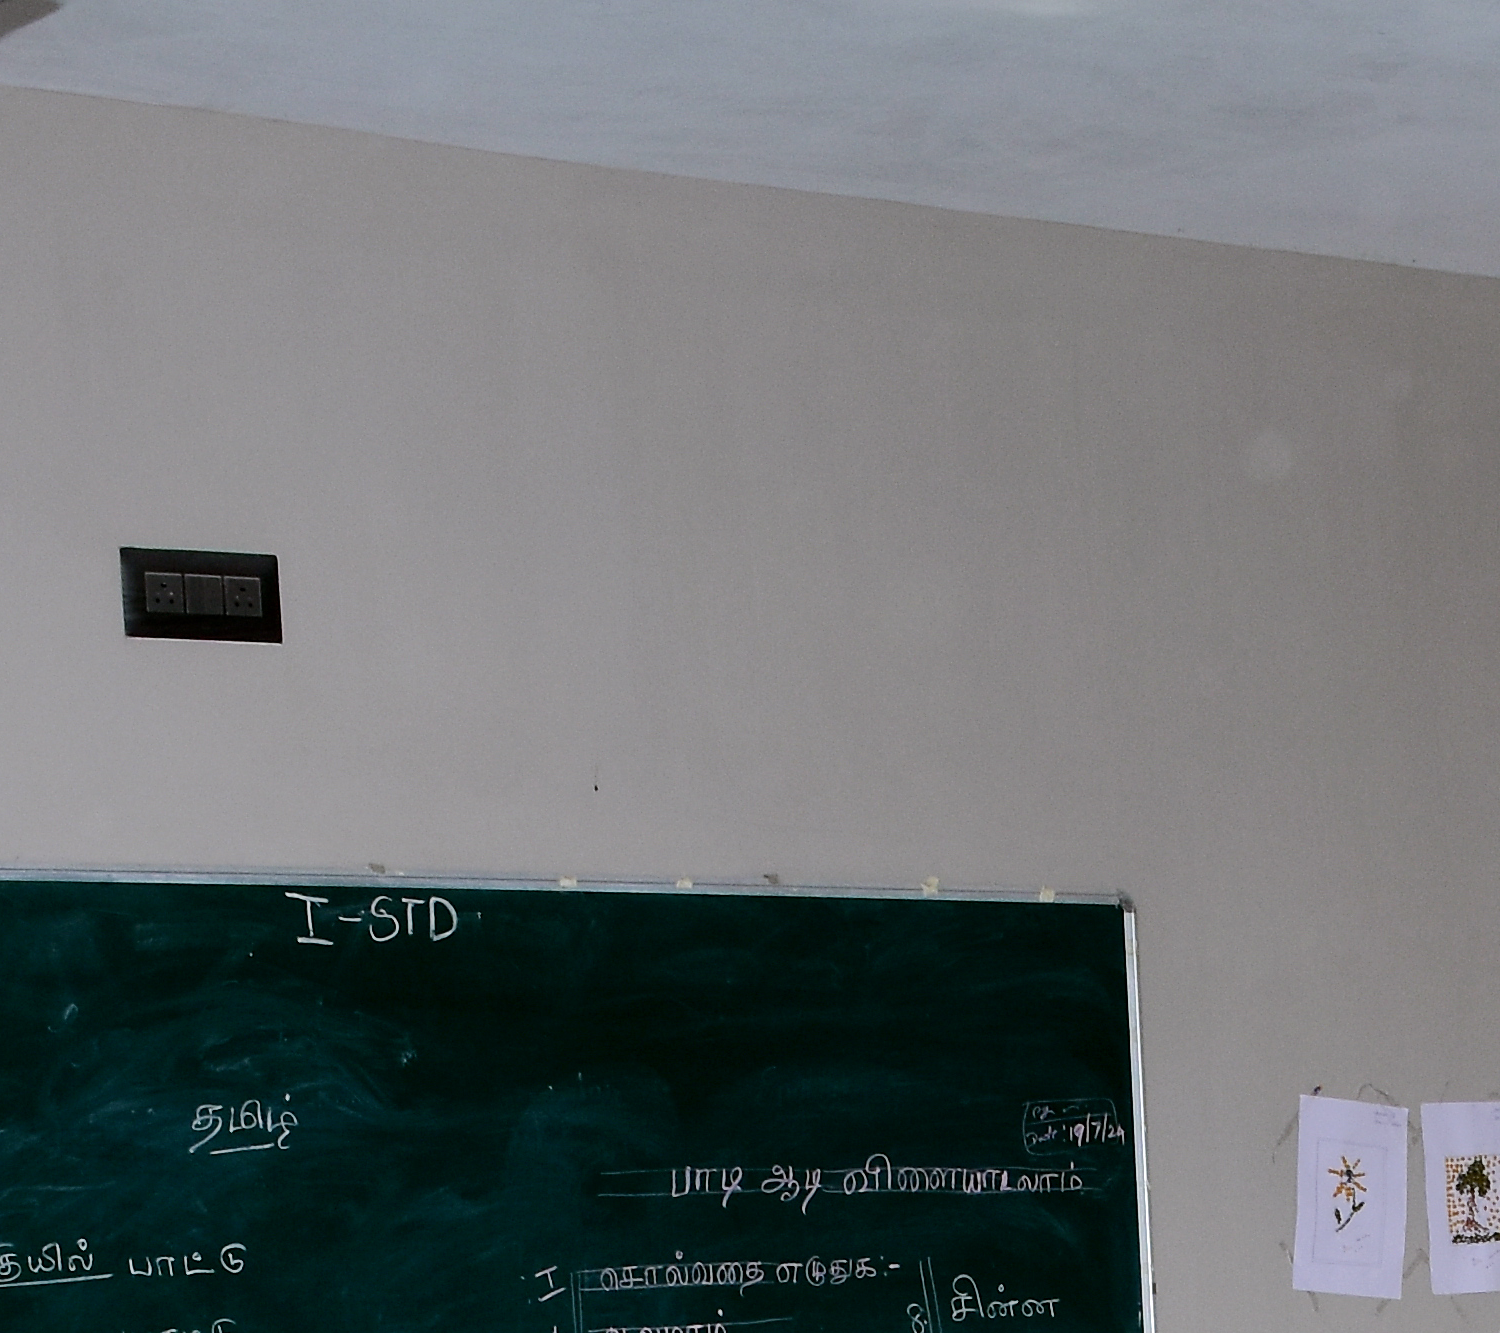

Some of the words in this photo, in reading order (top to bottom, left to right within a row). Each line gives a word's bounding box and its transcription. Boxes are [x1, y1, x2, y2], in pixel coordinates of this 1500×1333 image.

[189, 1093, 298, 1153] தமிழ்
[672, 1166, 742, 1208] பாடி
[762, 1164, 821, 1214] ஆடி
[843, 1154, 1083, 1196] விளையாடலாம்
[129, 1243, 246, 1276] பாட்டு
[600, 1251, 765, 1297] சொல்வதை
[950, 1274, 1060, 1321] சின்ன
